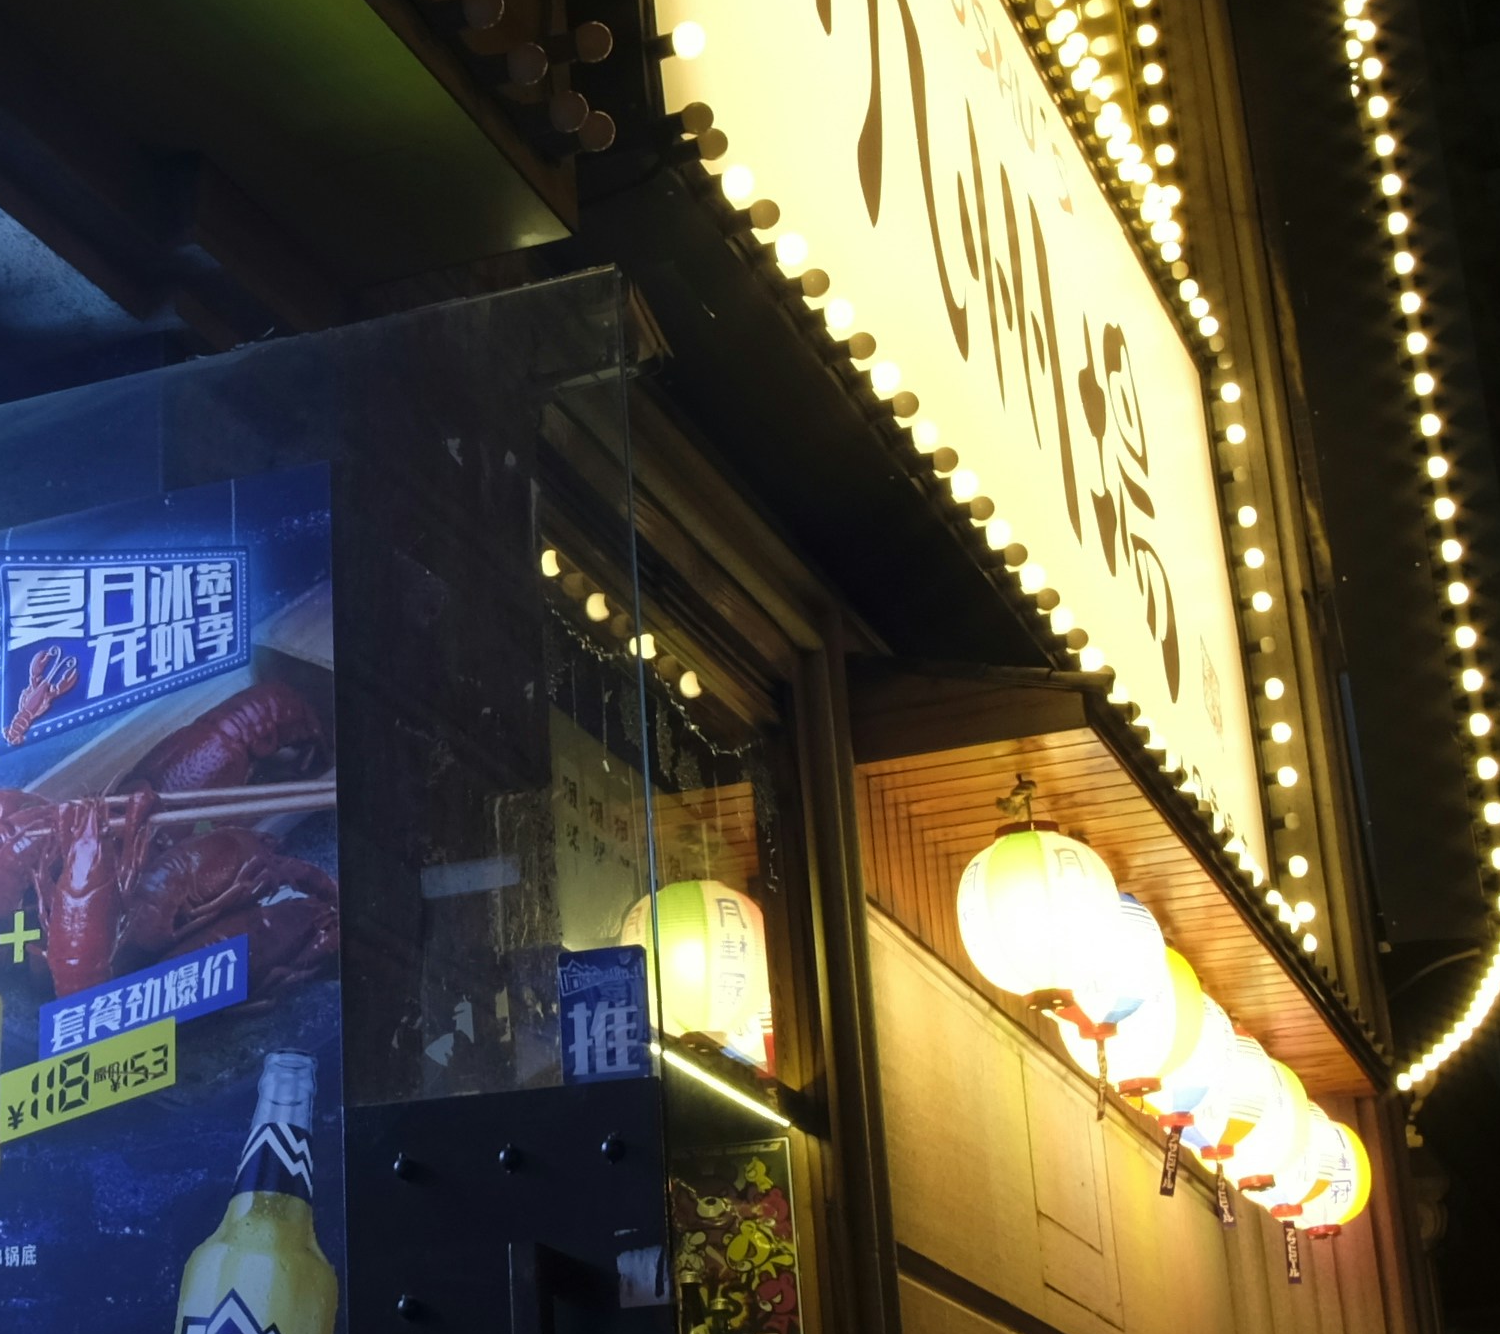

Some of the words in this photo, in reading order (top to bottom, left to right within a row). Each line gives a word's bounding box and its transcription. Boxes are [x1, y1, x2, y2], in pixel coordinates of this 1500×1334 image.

[8, 563, 231, 650] 夏日冰萃
[87, 612, 234, 699] 龙虾季
[50, 949, 237, 1053] 套餐劲爆价
[567, 999, 640, 1076] 推
